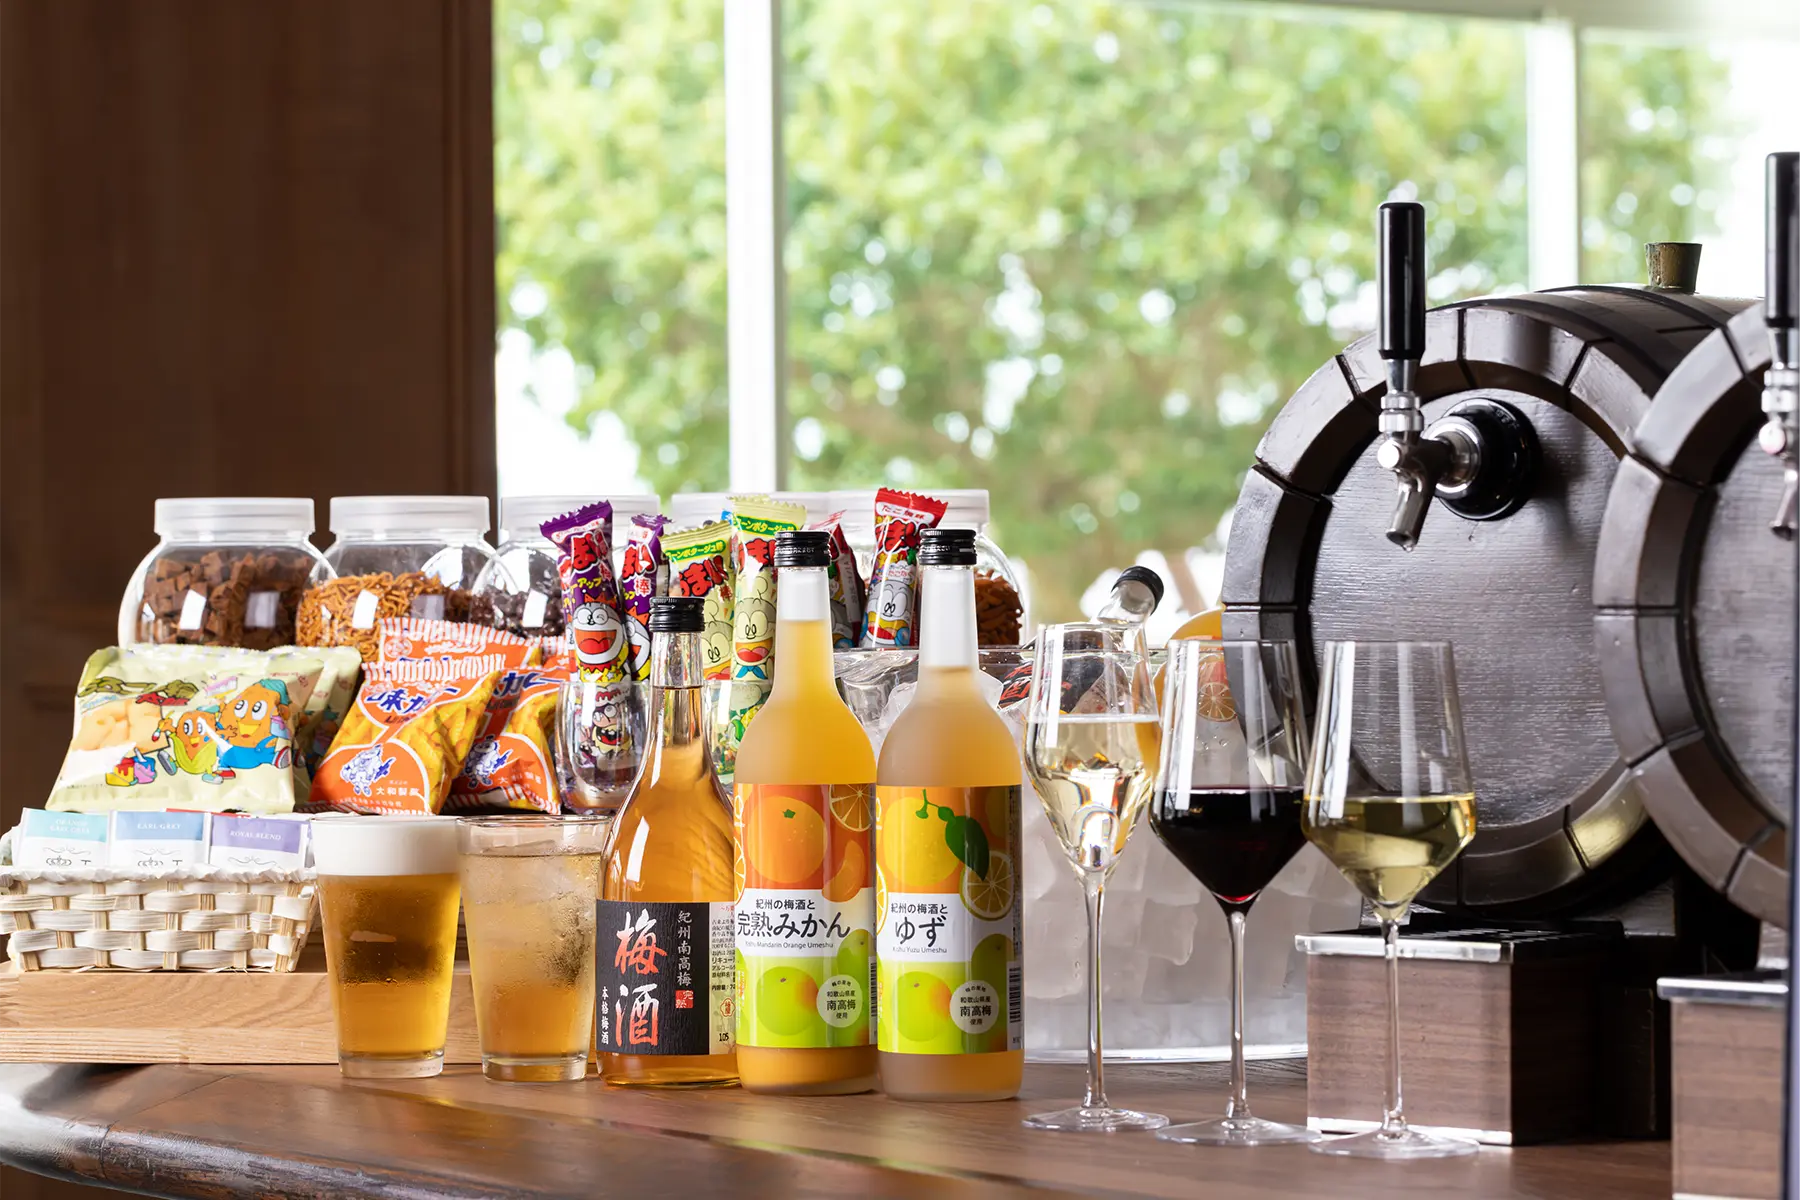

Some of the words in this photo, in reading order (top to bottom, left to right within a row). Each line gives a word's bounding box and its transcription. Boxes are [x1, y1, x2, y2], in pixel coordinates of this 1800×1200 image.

[229, 830, 254, 838] ROYAL
[755, 899, 816, 910] 紀州の梅酒と
[890, 903, 949, 915] 紀州の梅酒と
[737, 910, 851, 939] 完熟みかん
[895, 915, 947, 947] ゆず
[677, 910, 693, 986] 紀州南高梅
[614, 908, 668, 1047] 梅酒
[826, 999, 856, 1011] 南高梅
[960, 1005, 992, 1017] 南高梅
[601, 986, 609, 1045] 本格梅酒
